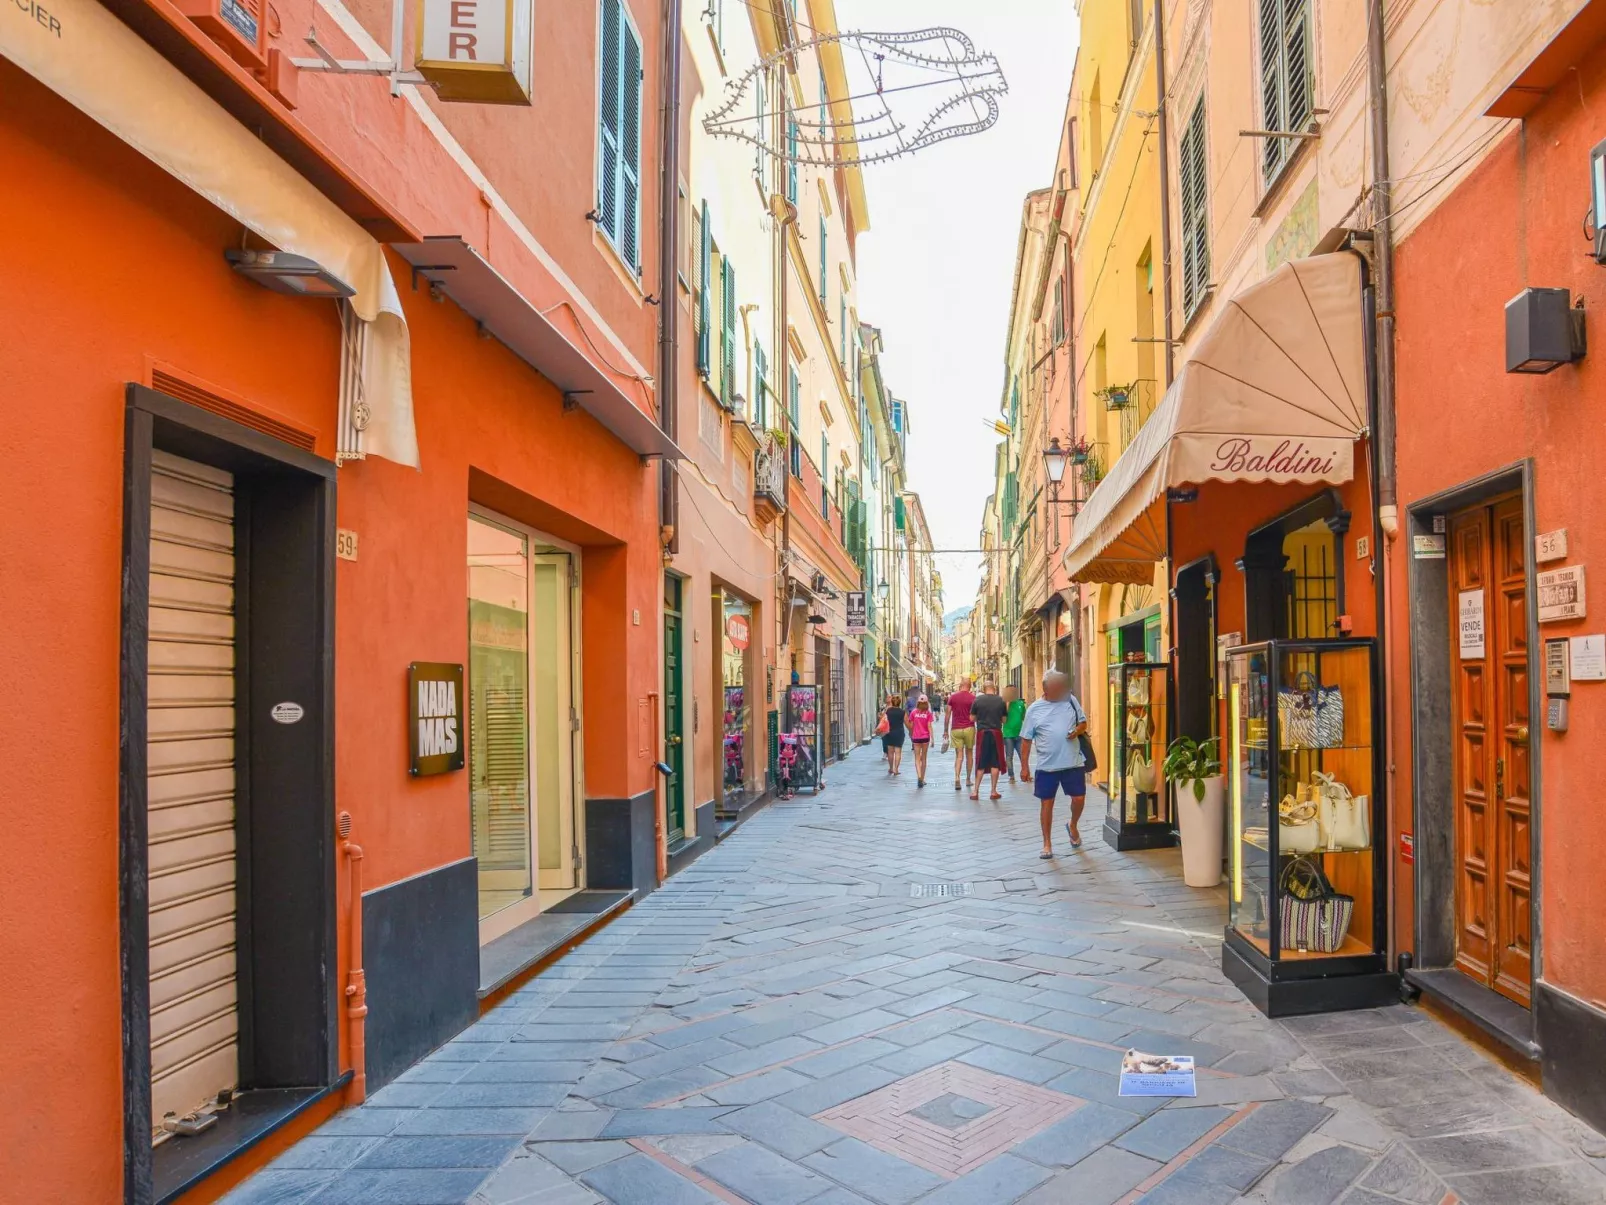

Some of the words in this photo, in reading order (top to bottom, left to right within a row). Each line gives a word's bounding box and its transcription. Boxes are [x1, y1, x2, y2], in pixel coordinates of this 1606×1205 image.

[1210, 438, 1337, 474] Baldini
[1542, 539, 1556, 553] 56
[1460, 621, 1481, 631] VENDE
[418, 680, 457, 718] NADA
[418, 717, 457, 757] MAS
